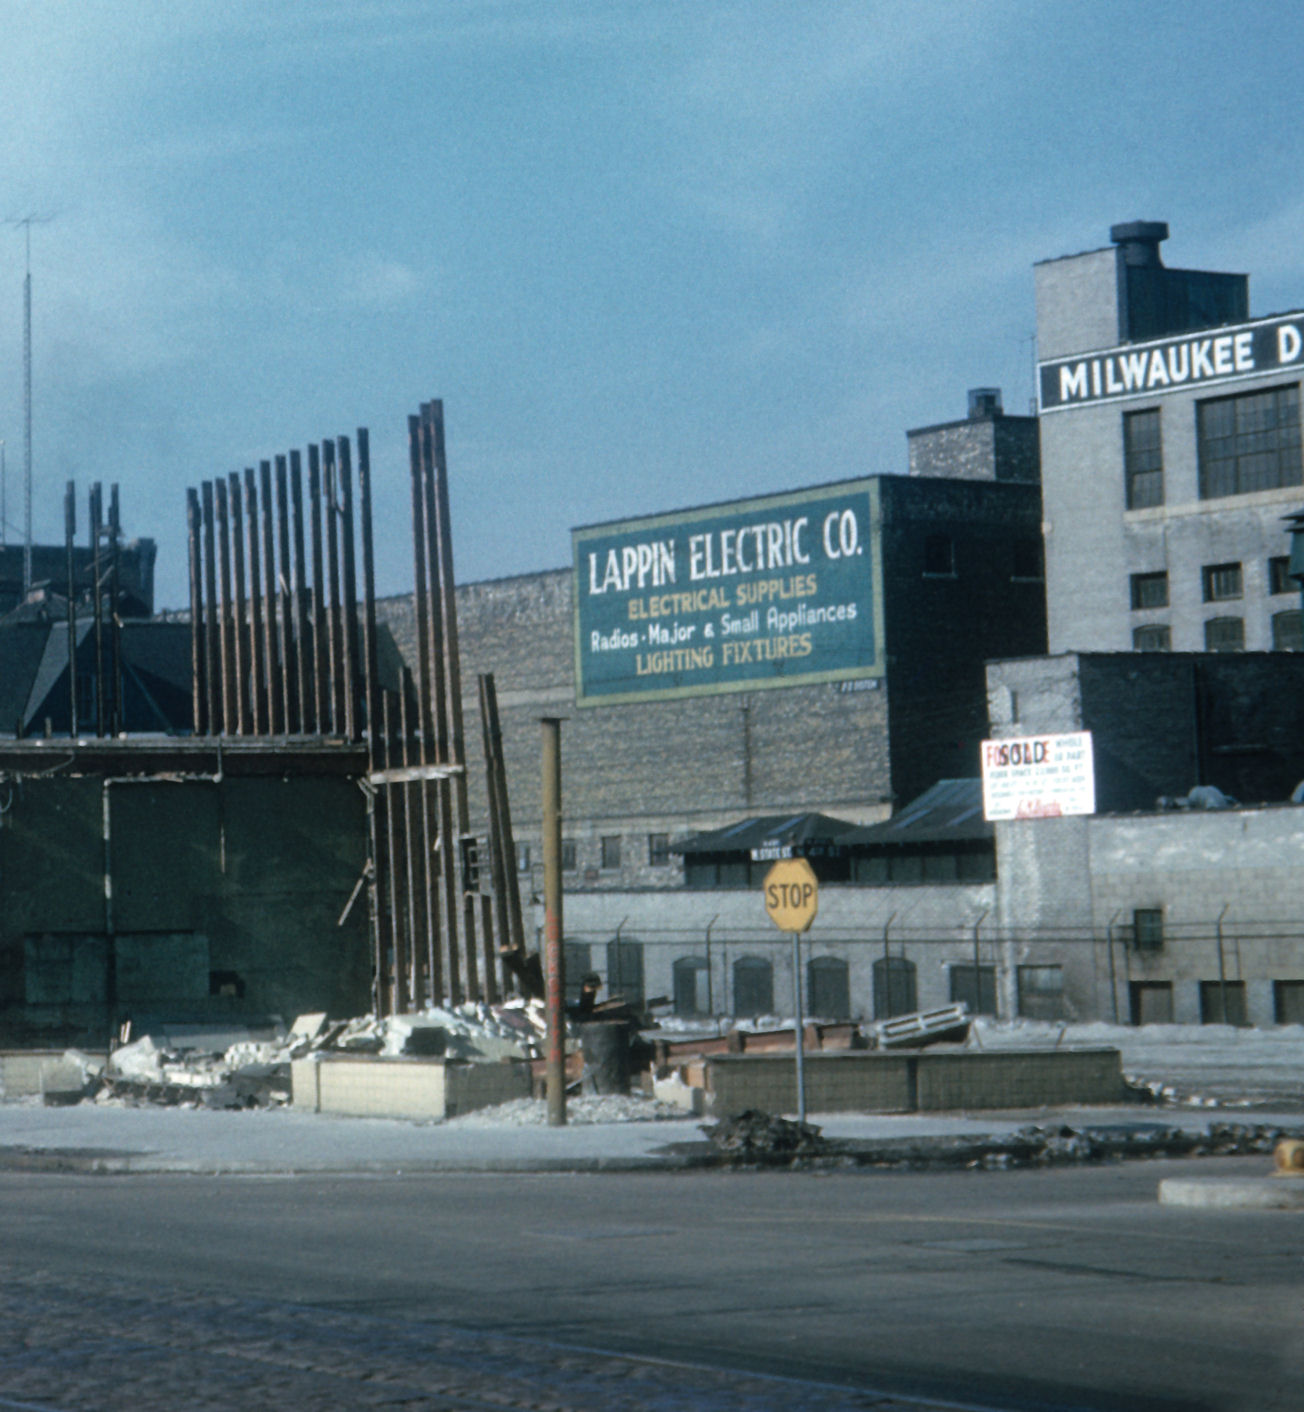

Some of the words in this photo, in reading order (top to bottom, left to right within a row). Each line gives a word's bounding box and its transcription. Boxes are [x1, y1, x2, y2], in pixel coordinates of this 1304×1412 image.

[1060, 332, 1256, 401] MILWAUKEE
[589, 539, 676, 595] LAPPIN
[689, 517, 810, 581] ELECTRIC
[823, 509, 863, 559] CO.
[629, 588, 730, 620] ELECTRICAL
[737, 573, 817, 606] SUPPLIES
[592, 628, 638, 652] Radios
[649, 622, 695, 645] Major
[721, 611, 759, 636] Small
[767, 601, 857, 633] Appliances
[636, 646, 714, 676] LIGHTING
[722, 632, 813, 666] FIXTURES
[768, 883, 813, 909] STOP
